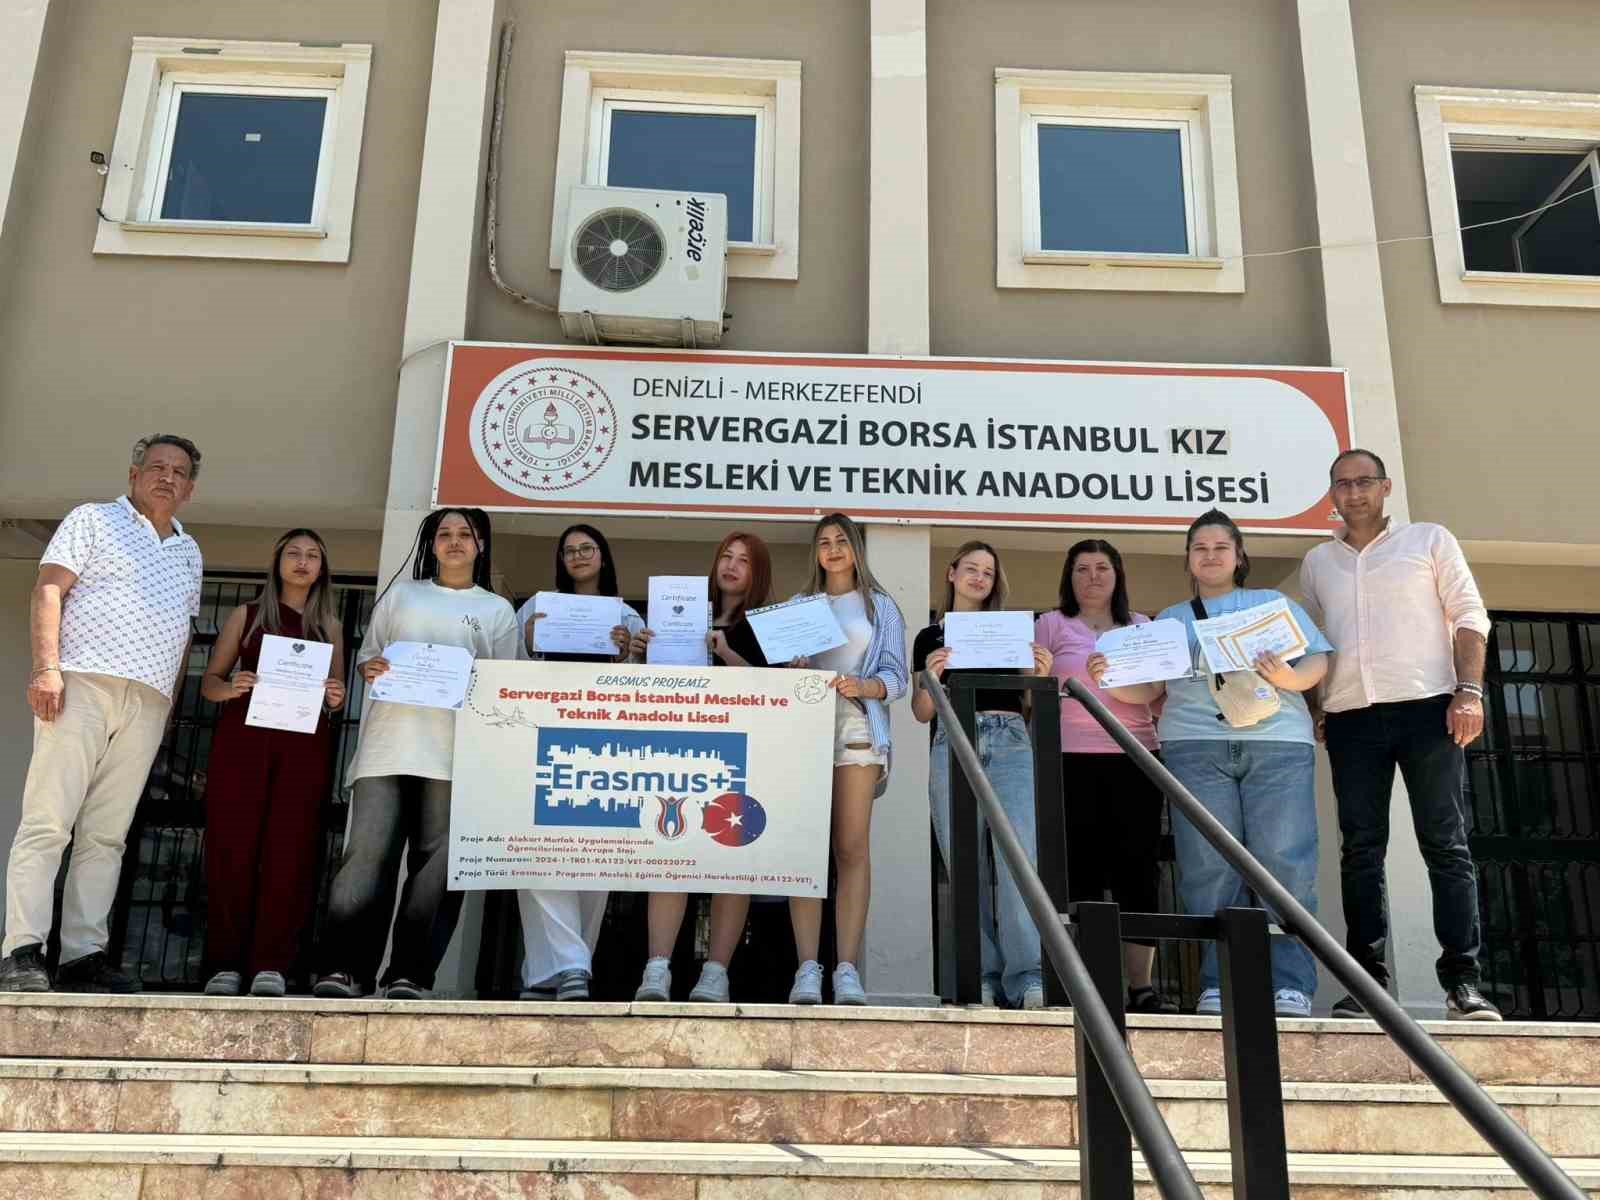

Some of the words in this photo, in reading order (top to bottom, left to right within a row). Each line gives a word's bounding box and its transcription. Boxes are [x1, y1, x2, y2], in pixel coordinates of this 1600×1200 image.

[686, 197, 707, 262] arçelik
[633, 376, 724, 399] DENİZLİ
[745, 381, 922, 404] MERKEZEFENDİ
[631, 413, 848, 446] SERVERGAZİ
[859, 420, 977, 449] BORSA
[987, 417, 1159, 454] İSTANBUL
[1171, 428, 1228, 455] KIZ
[629, 459, 778, 491] MESLEKİ
[787, 465, 832, 492] VE
[839, 463, 967, 496] TEKNİK
[976, 470, 1153, 500] ANADOLU
[1165, 469, 1270, 504] LİSESİ
[596, 675, 651, 687] ERASMUS
[652, 677, 711, 689] PROJEMİZ
[499, 687, 583, 703] Servergazi
[586, 690, 631, 703] Borsa
[635, 690, 700, 704] İstanbul
[704, 693, 765, 706] Mesleki
[769, 698, 788, 706] ve
[557, 708, 612, 720] Teknik
[616, 710, 683, 722] Anadolu
[687, 711, 730, 723] Lisesi
[552, 763, 730, 793] Erasmus+
[460, 835, 484, 844] Proje
[508, 835, 542, 843] Alakart
[578, 837, 655, 846] Uygulamalarında
[582, 846, 614, 855] Avrupa
[459, 856, 483, 864] Proje
[458, 870, 482, 878] Proje
[599, 871, 632, 879] Mesleki
